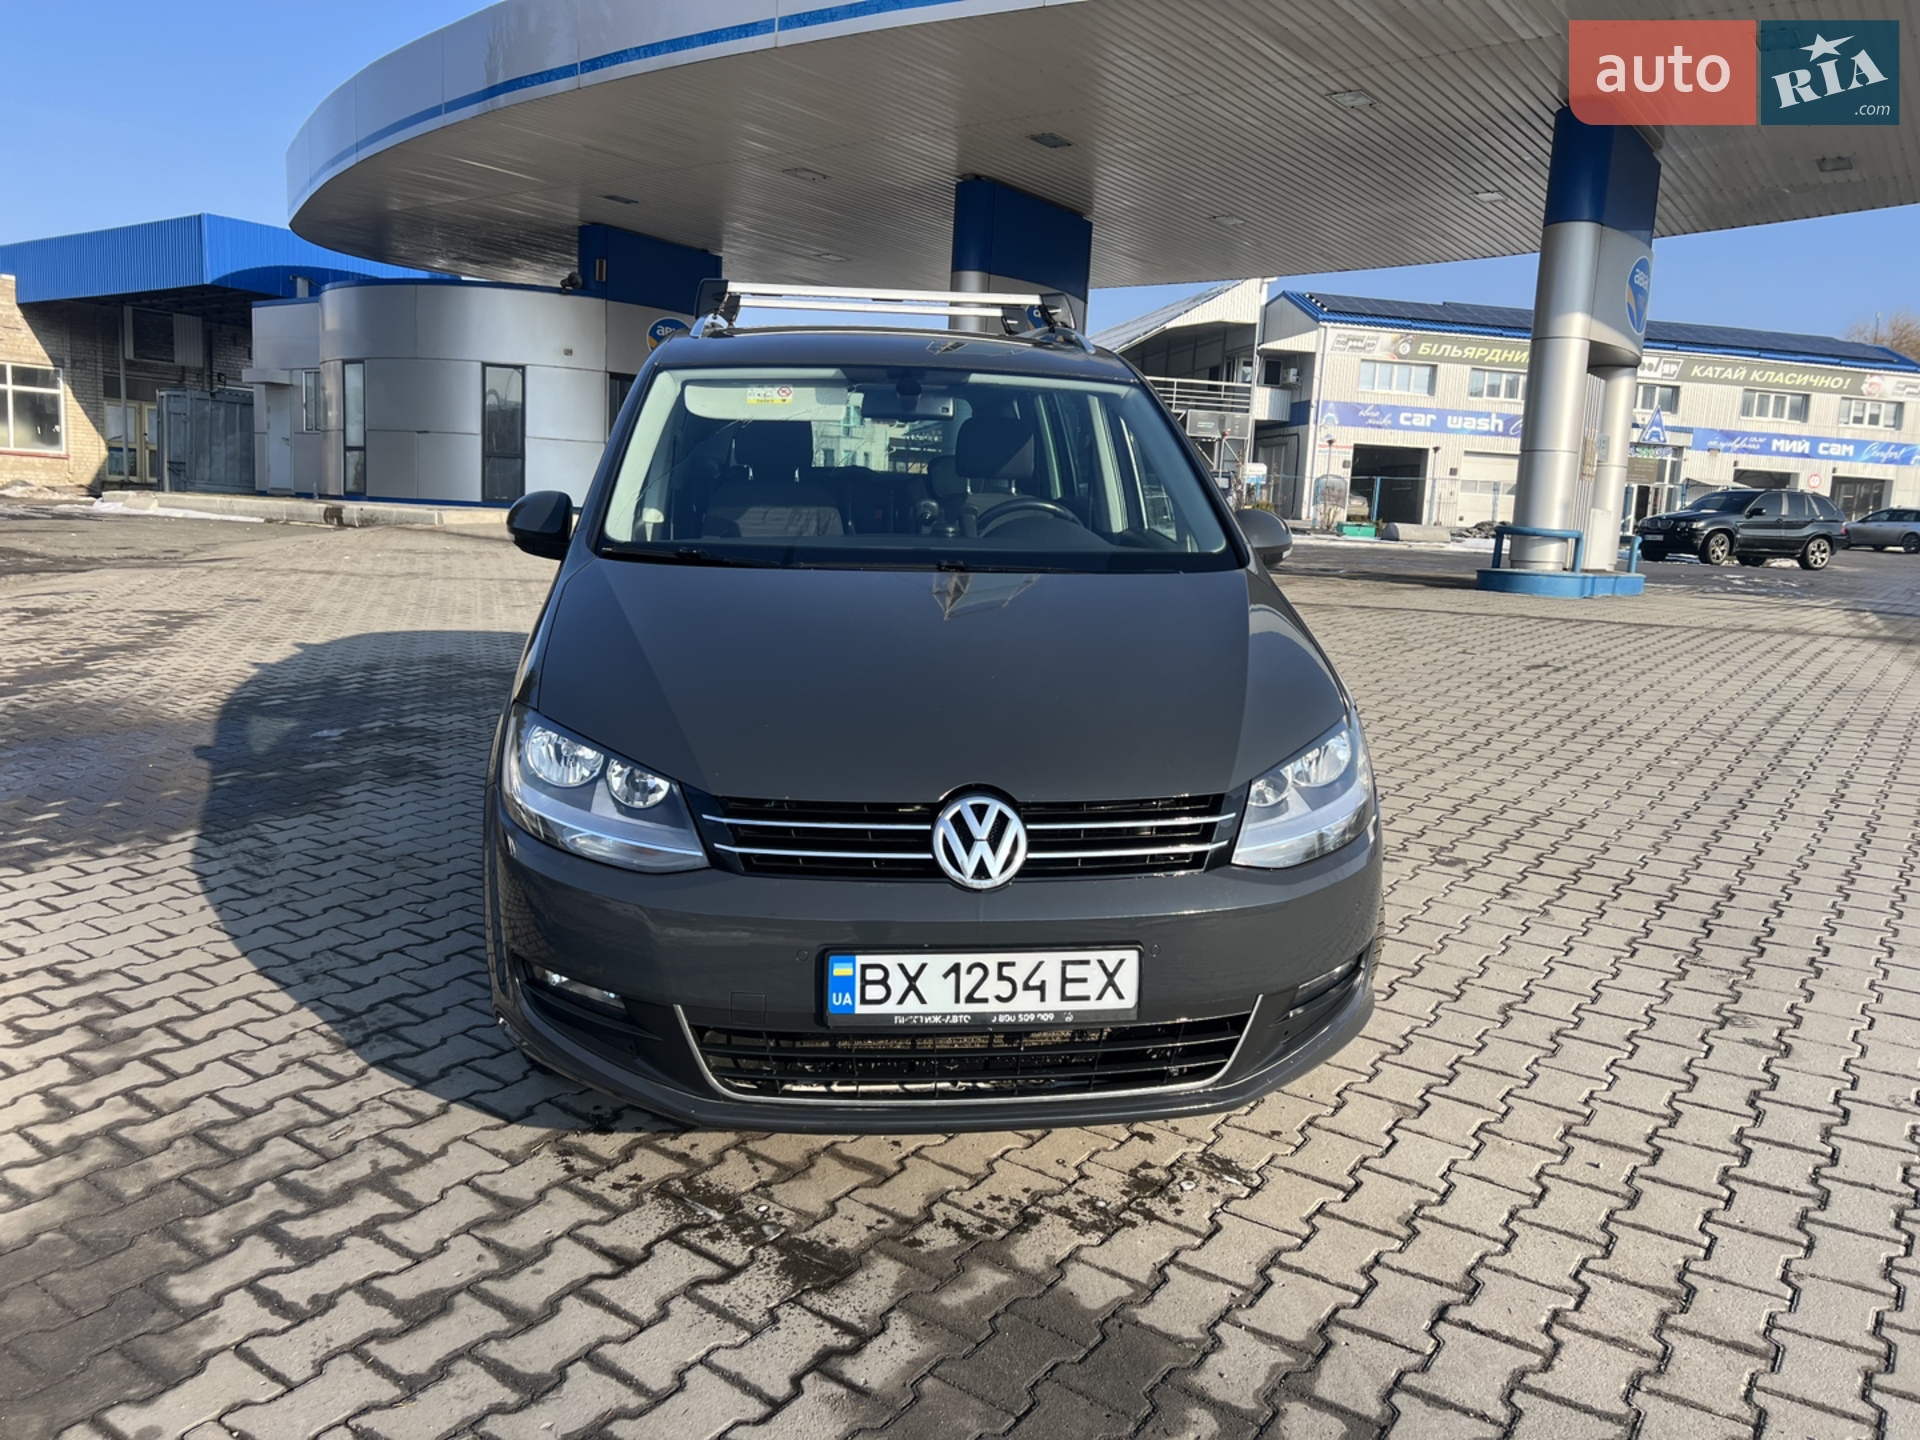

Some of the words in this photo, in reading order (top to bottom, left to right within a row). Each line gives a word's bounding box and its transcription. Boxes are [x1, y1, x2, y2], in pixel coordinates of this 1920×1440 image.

[1690, 364, 1747, 381] КАТАЙ
[1749, 370, 1852, 390] КЛАСИЧНО!
[1399, 412, 1437, 428] car
[1446, 412, 1504, 433] wash
[859, 962, 929, 1005] BX
[942, 960, 1047, 1005] 1254
[1060, 958, 1126, 1002] EX
[832, 992, 853, 1006] UA
[1018, 1012, 1036, 1022] 509
